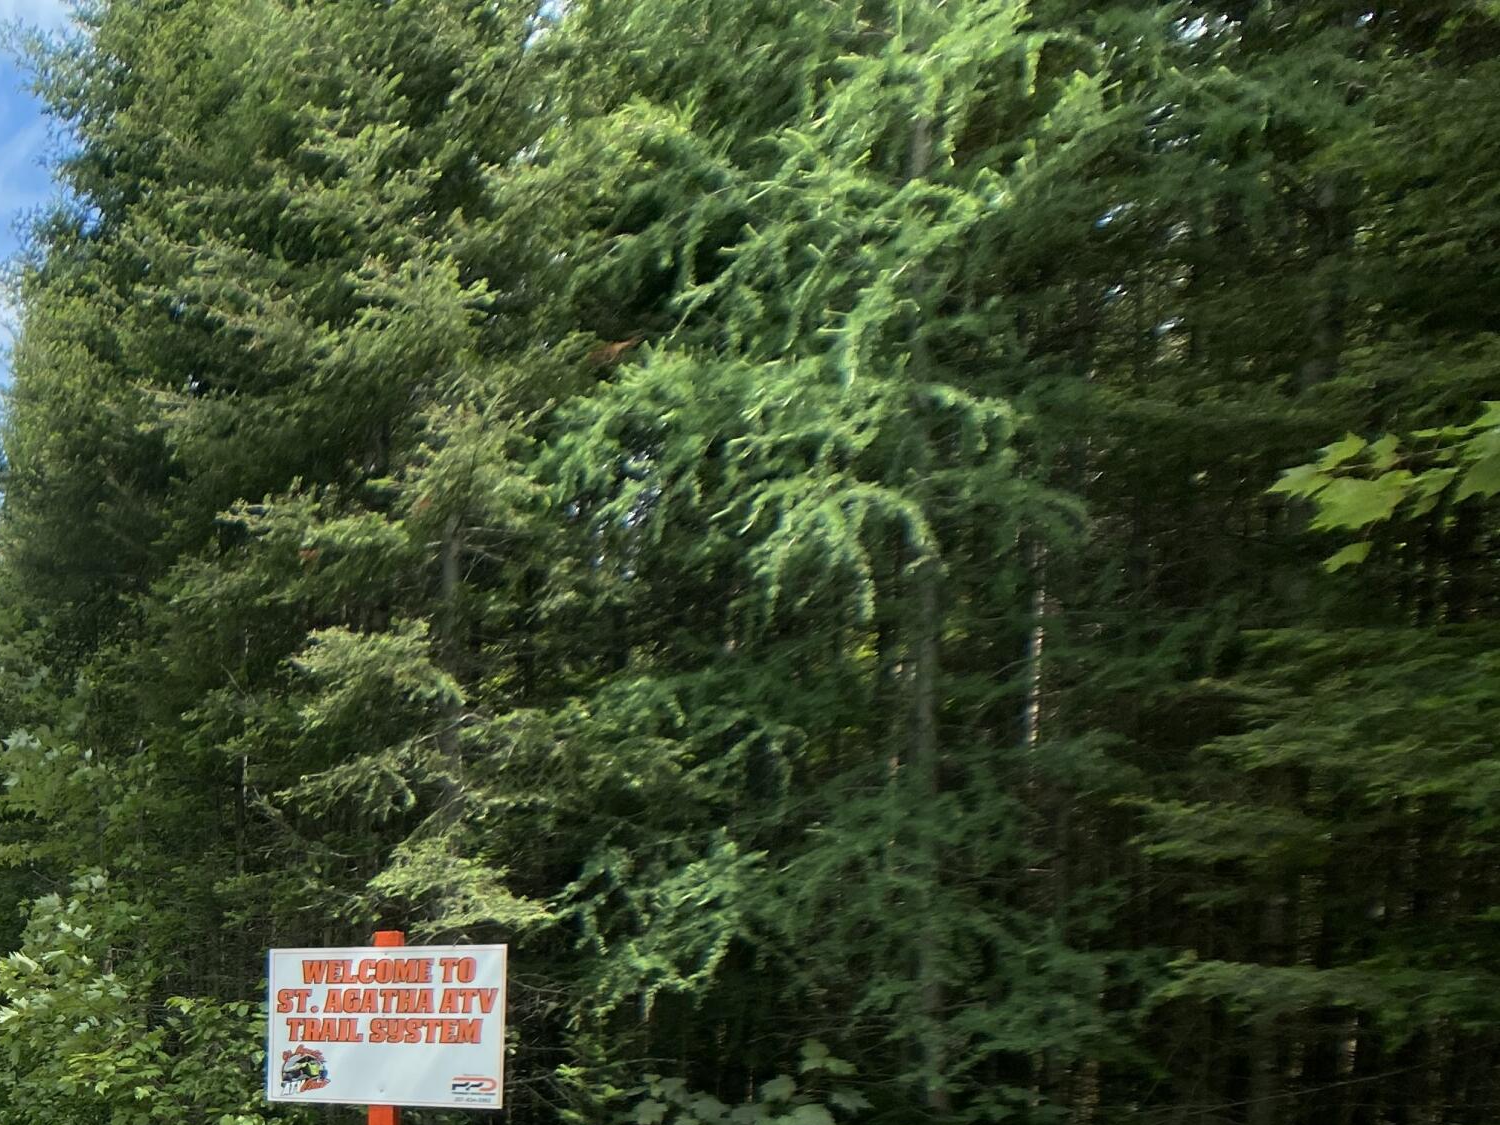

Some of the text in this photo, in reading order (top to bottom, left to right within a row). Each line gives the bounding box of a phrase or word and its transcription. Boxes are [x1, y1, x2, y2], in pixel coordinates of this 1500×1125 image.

[302, 957, 476, 984] WELCOME TO
[277, 988, 498, 1014] ST. AGATHA ATV
[286, 1018, 484, 1044] TRAIL SYSTEM
